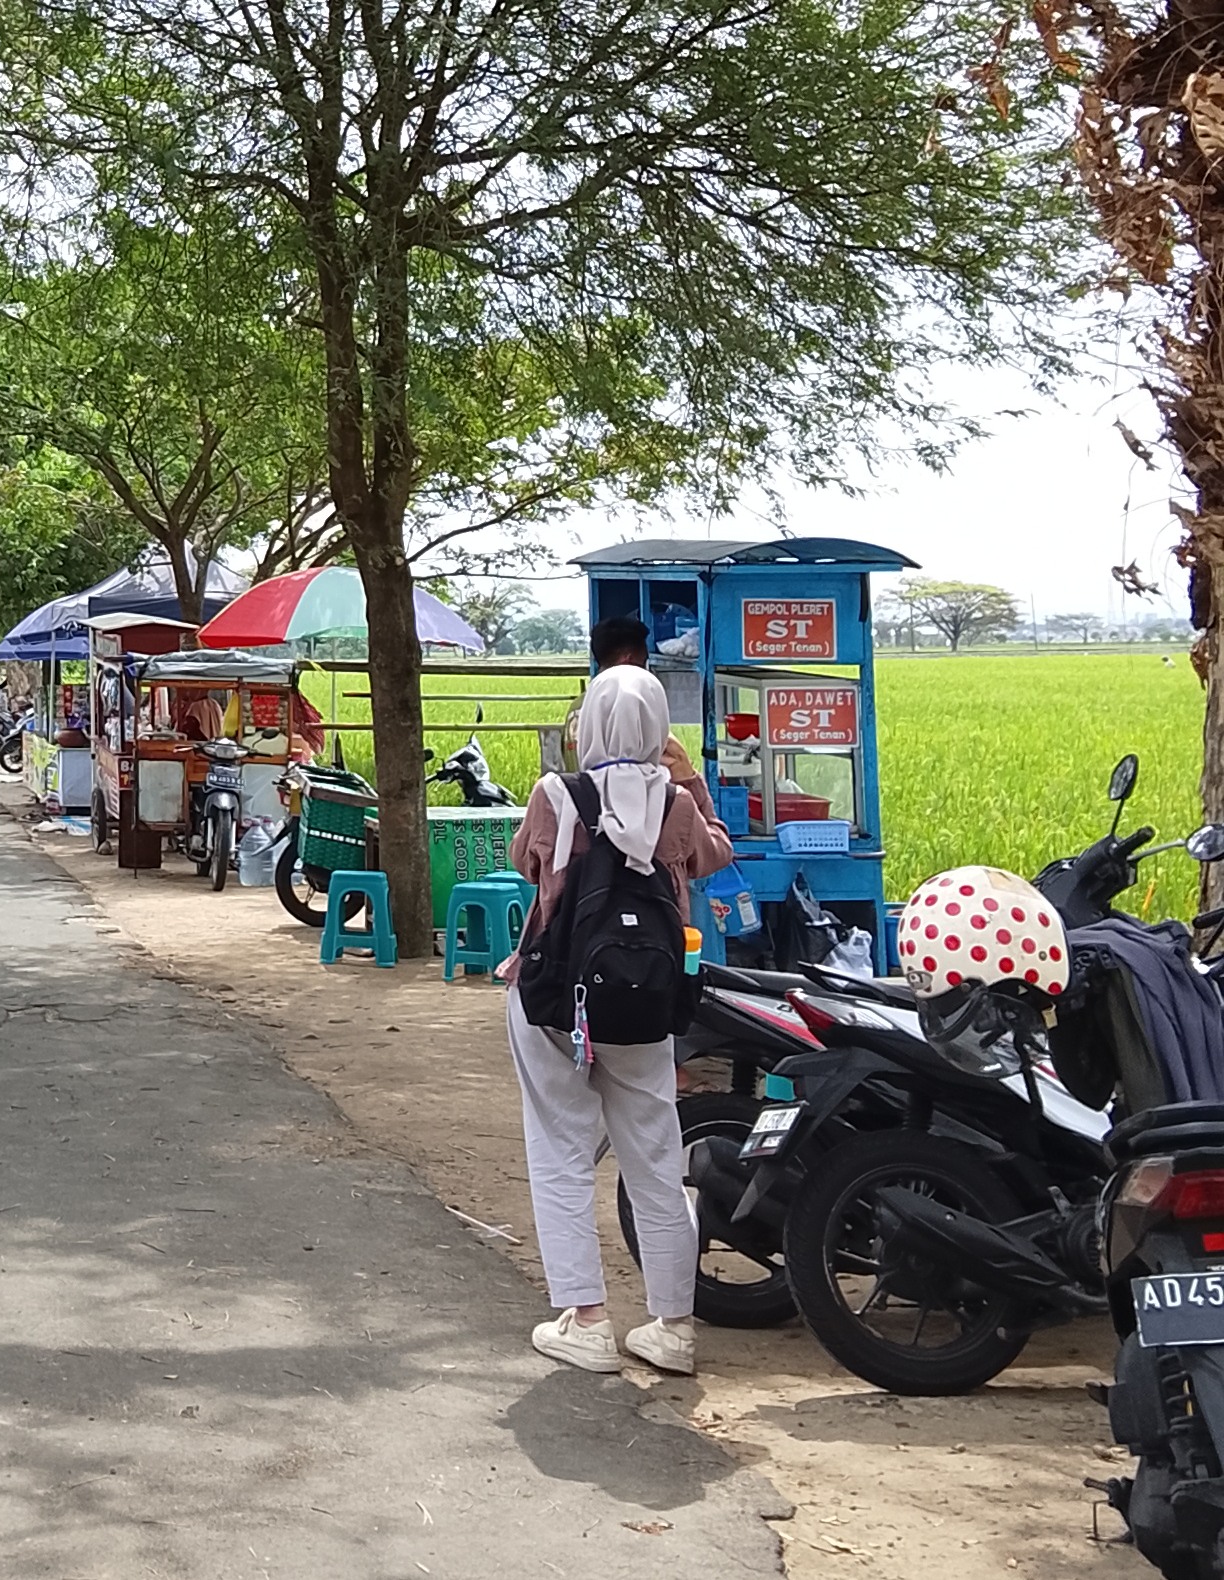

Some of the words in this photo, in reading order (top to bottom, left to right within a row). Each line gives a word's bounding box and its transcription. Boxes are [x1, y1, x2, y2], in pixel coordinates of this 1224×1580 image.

[748, 604, 789, 615] GEMPOL
[791, 604, 829, 615] PLERET
[765, 620, 813, 638] ST
[769, 692, 803, 707] ADA,
[805, 691, 853, 706] DAWET
[789, 709, 836, 727] ST
[455, 837, 468, 880] GOOD
[473, 837, 487, 866] POP
[1143, 1278, 1182, 1311] AD
